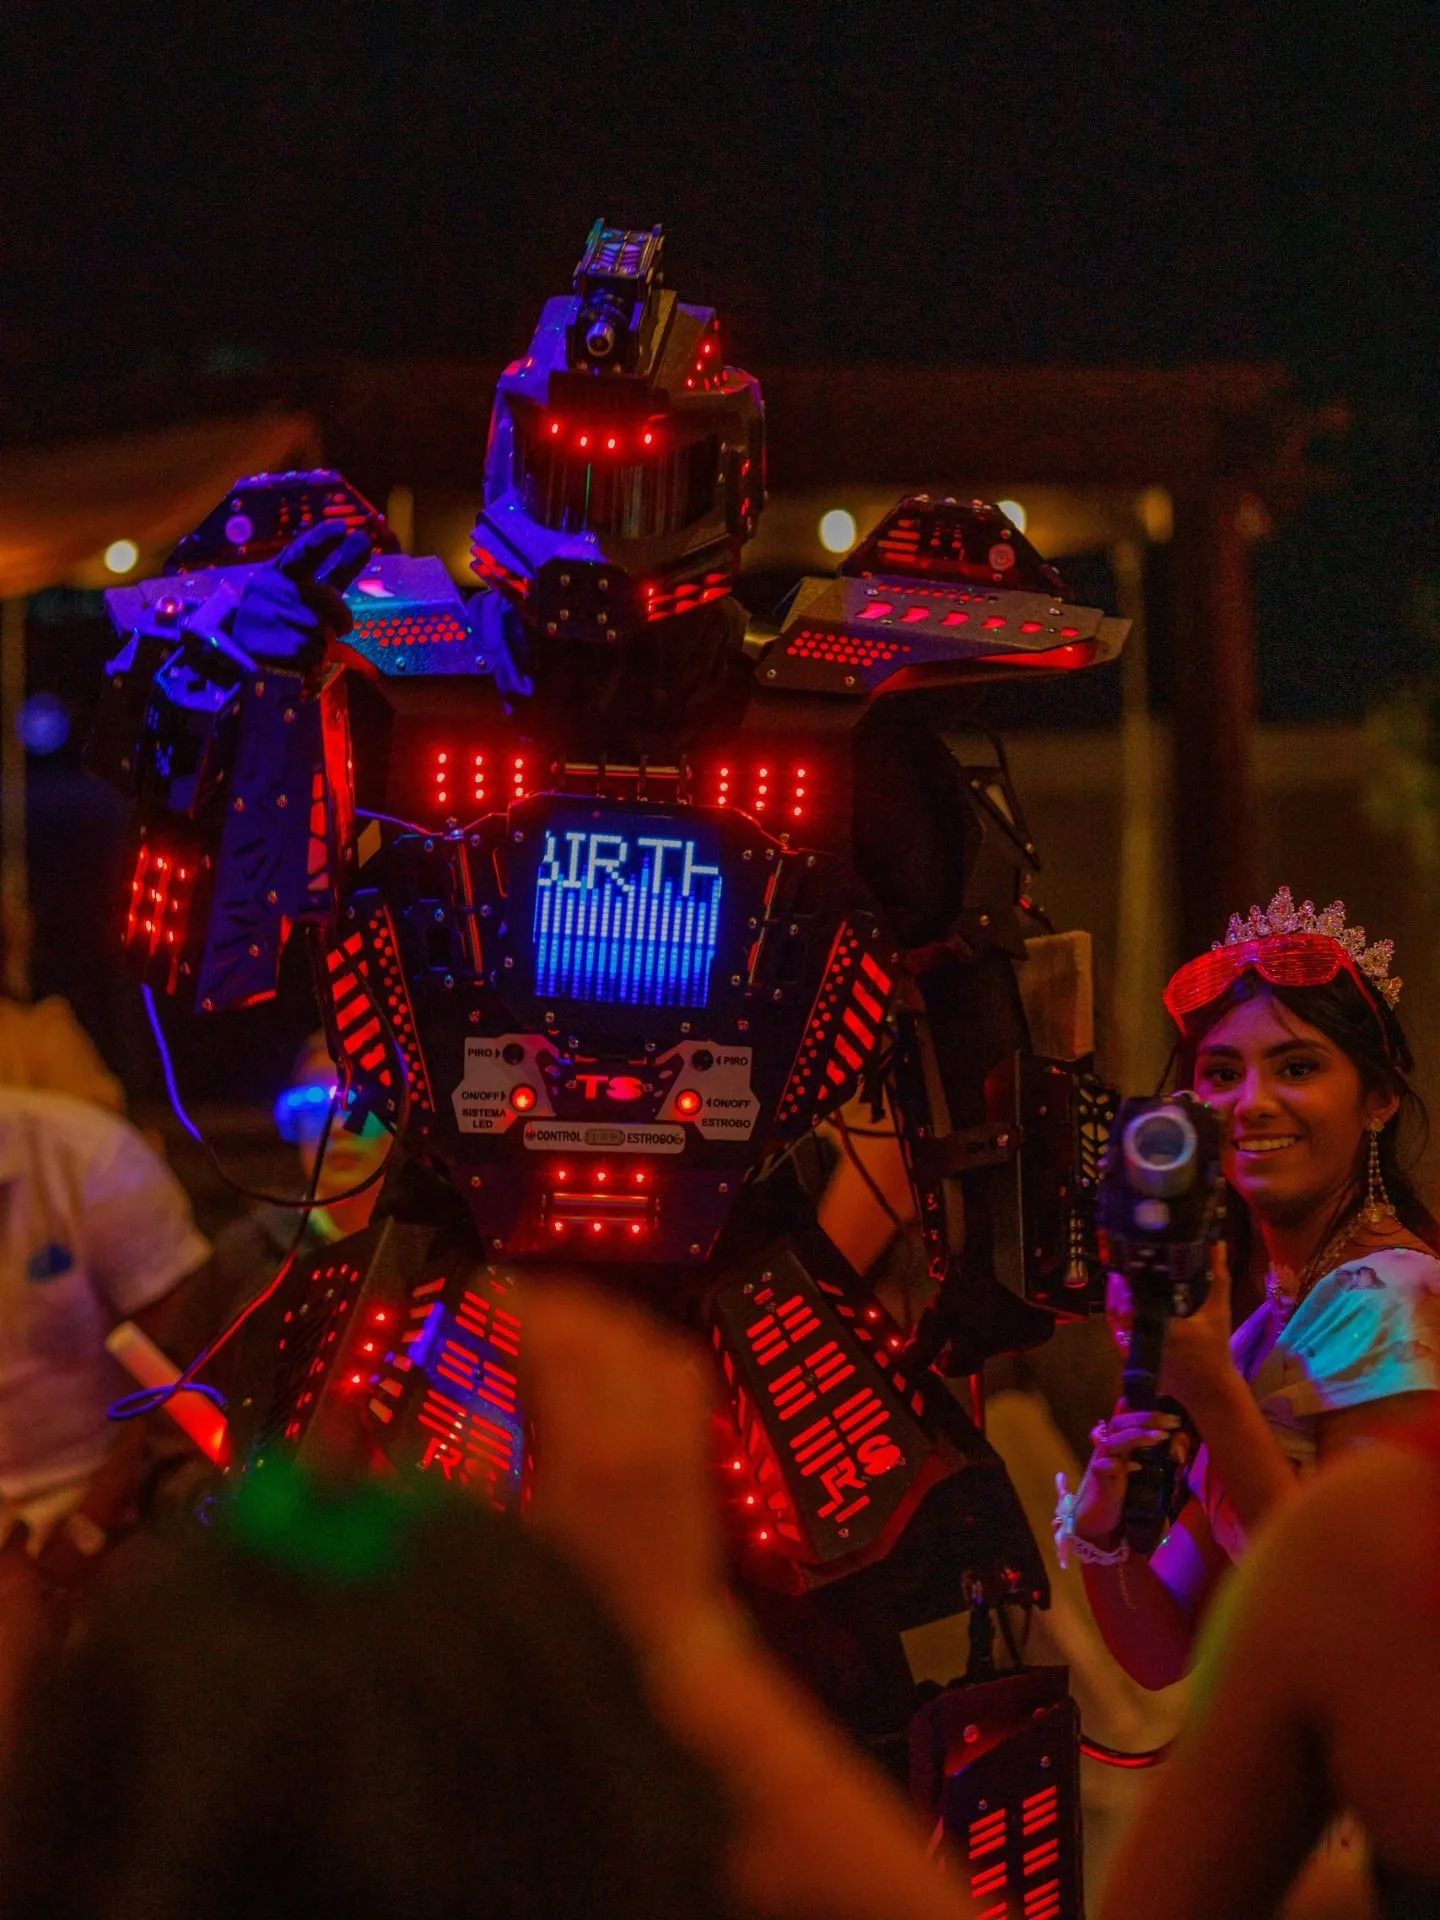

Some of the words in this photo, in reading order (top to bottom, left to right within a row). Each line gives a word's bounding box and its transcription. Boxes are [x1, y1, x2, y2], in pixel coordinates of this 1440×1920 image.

[468, 1048, 493, 1058] PIRO
[723, 1056, 748, 1066] PIRO
[575, 1074, 645, 1102] TS
[462, 1091, 499, 1101] ON/OFF
[712, 1099, 751, 1109] ON/OFF
[462, 1108, 506, 1118] SISTEMA
[473, 1119, 493, 1129] LED
[702, 1118, 751, 1129] ESTROBO
[536, 1131, 582, 1142] CONTROL
[627, 1133, 674, 1145] ESTROBO
